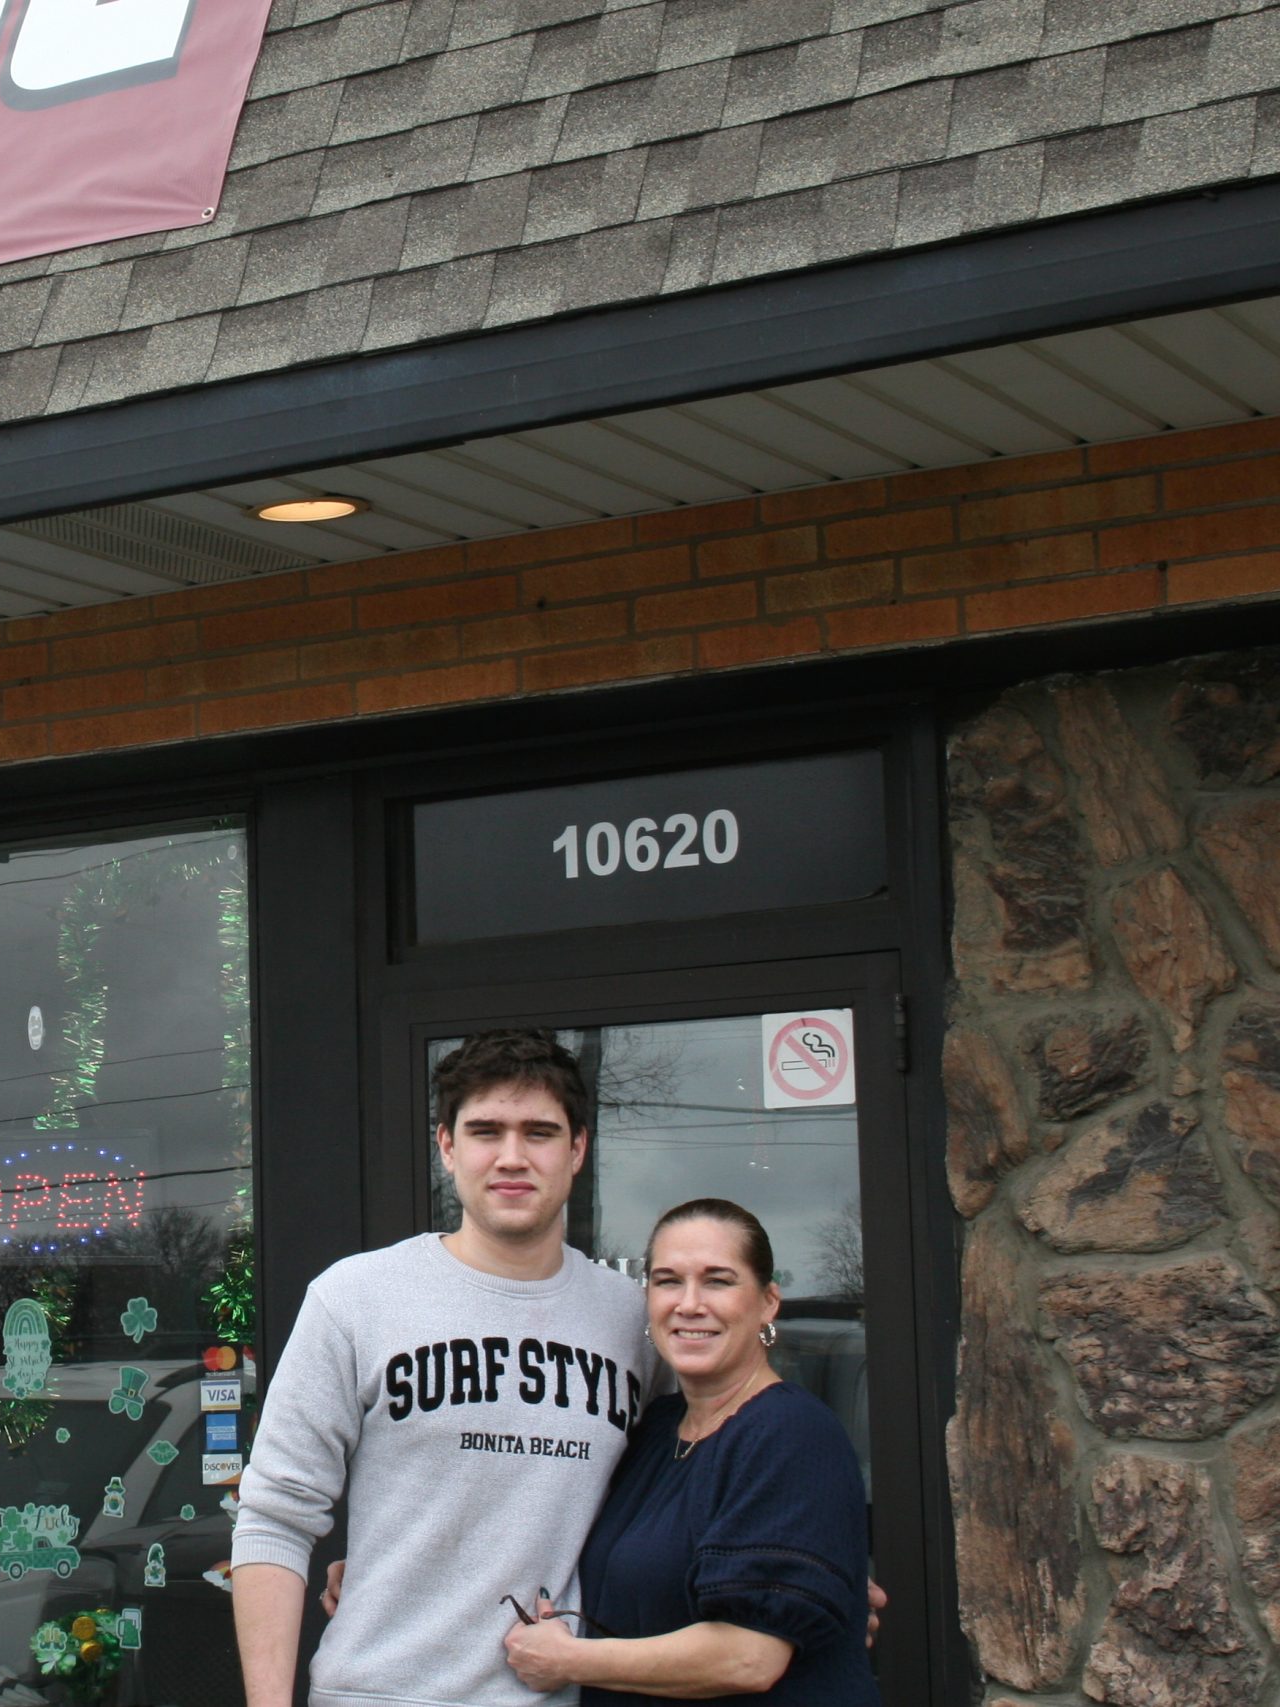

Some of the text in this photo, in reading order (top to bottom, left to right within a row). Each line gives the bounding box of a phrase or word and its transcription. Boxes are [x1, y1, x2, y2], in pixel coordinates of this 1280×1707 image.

[552, 808, 739, 878] 10620
[206, 1389, 236, 1401] VISA
[386, 1337, 510, 1421] SURF
[460, 1432, 591, 1460] BONITA BEACH
